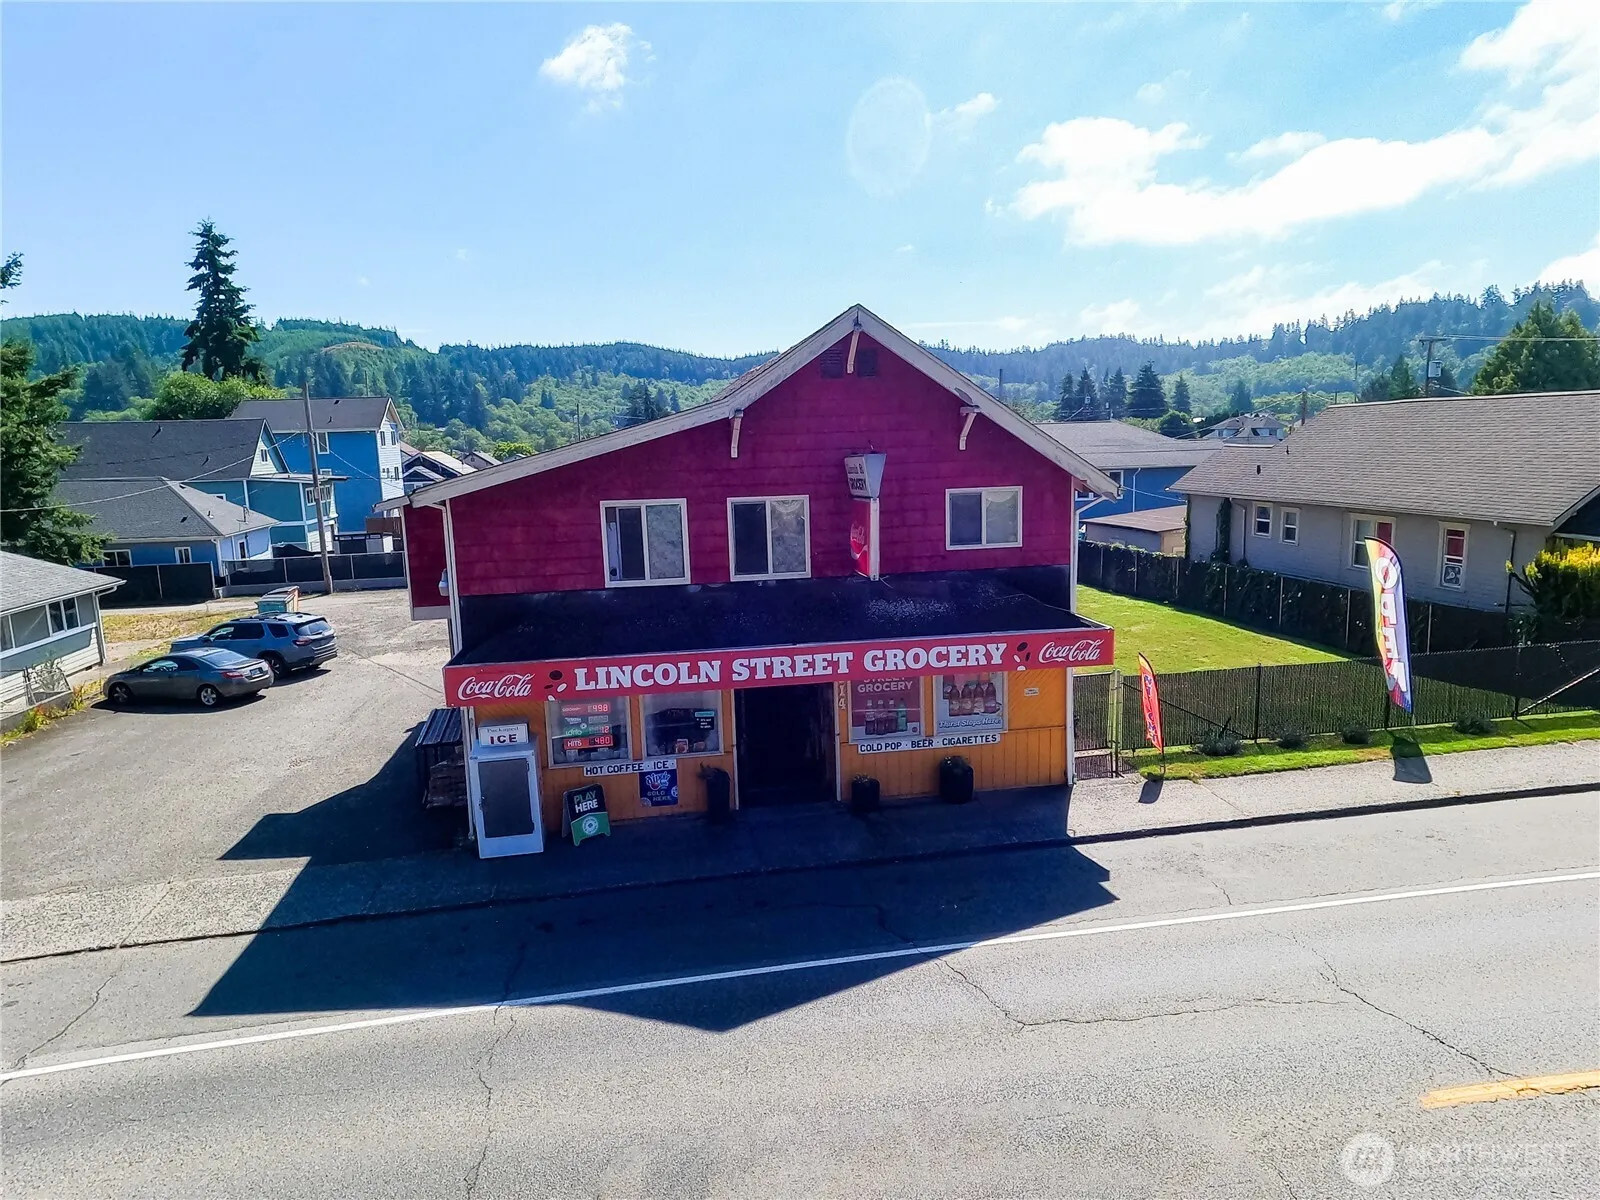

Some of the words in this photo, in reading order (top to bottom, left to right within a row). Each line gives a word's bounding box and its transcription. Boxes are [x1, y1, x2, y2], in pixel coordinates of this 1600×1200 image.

[1038, 639, 1104, 664] Coca-Cola
[574, 660, 721, 691] LINCOLN
[731, 652, 853, 681] STREET
[863, 643, 1007, 672] GROCERY
[458, 673, 535, 700] Coca-Cola
[857, 681, 913, 693] GROCERY
[490, 733, 517, 745] ICE
[860, 743, 882, 752] COLD
[884, 742, 902, 751] POP
[911, 739, 934, 748] BEER
[942, 734, 997, 746] CIGARETTES
[585, 765, 604, 775] HOT
[607, 763, 645, 773] COFFEE
[653, 761, 669, 770] ICE
[574, 790, 596, 804] PLAY
[575, 799, 599, 813] HERE
